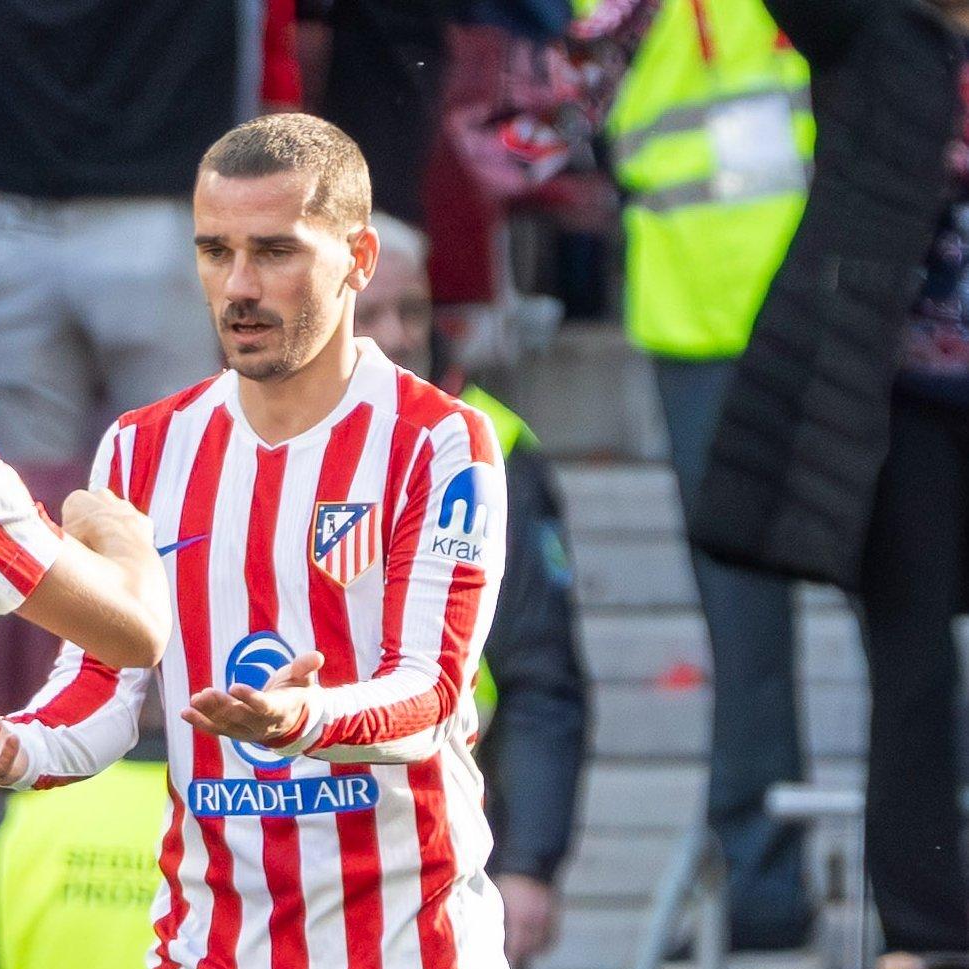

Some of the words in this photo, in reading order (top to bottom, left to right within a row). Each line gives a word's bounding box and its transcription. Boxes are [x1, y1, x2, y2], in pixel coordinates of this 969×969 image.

[431, 536, 482, 561] krak
[195, 782, 304, 812] RIYADH
[313, 777, 372, 810] AIR
